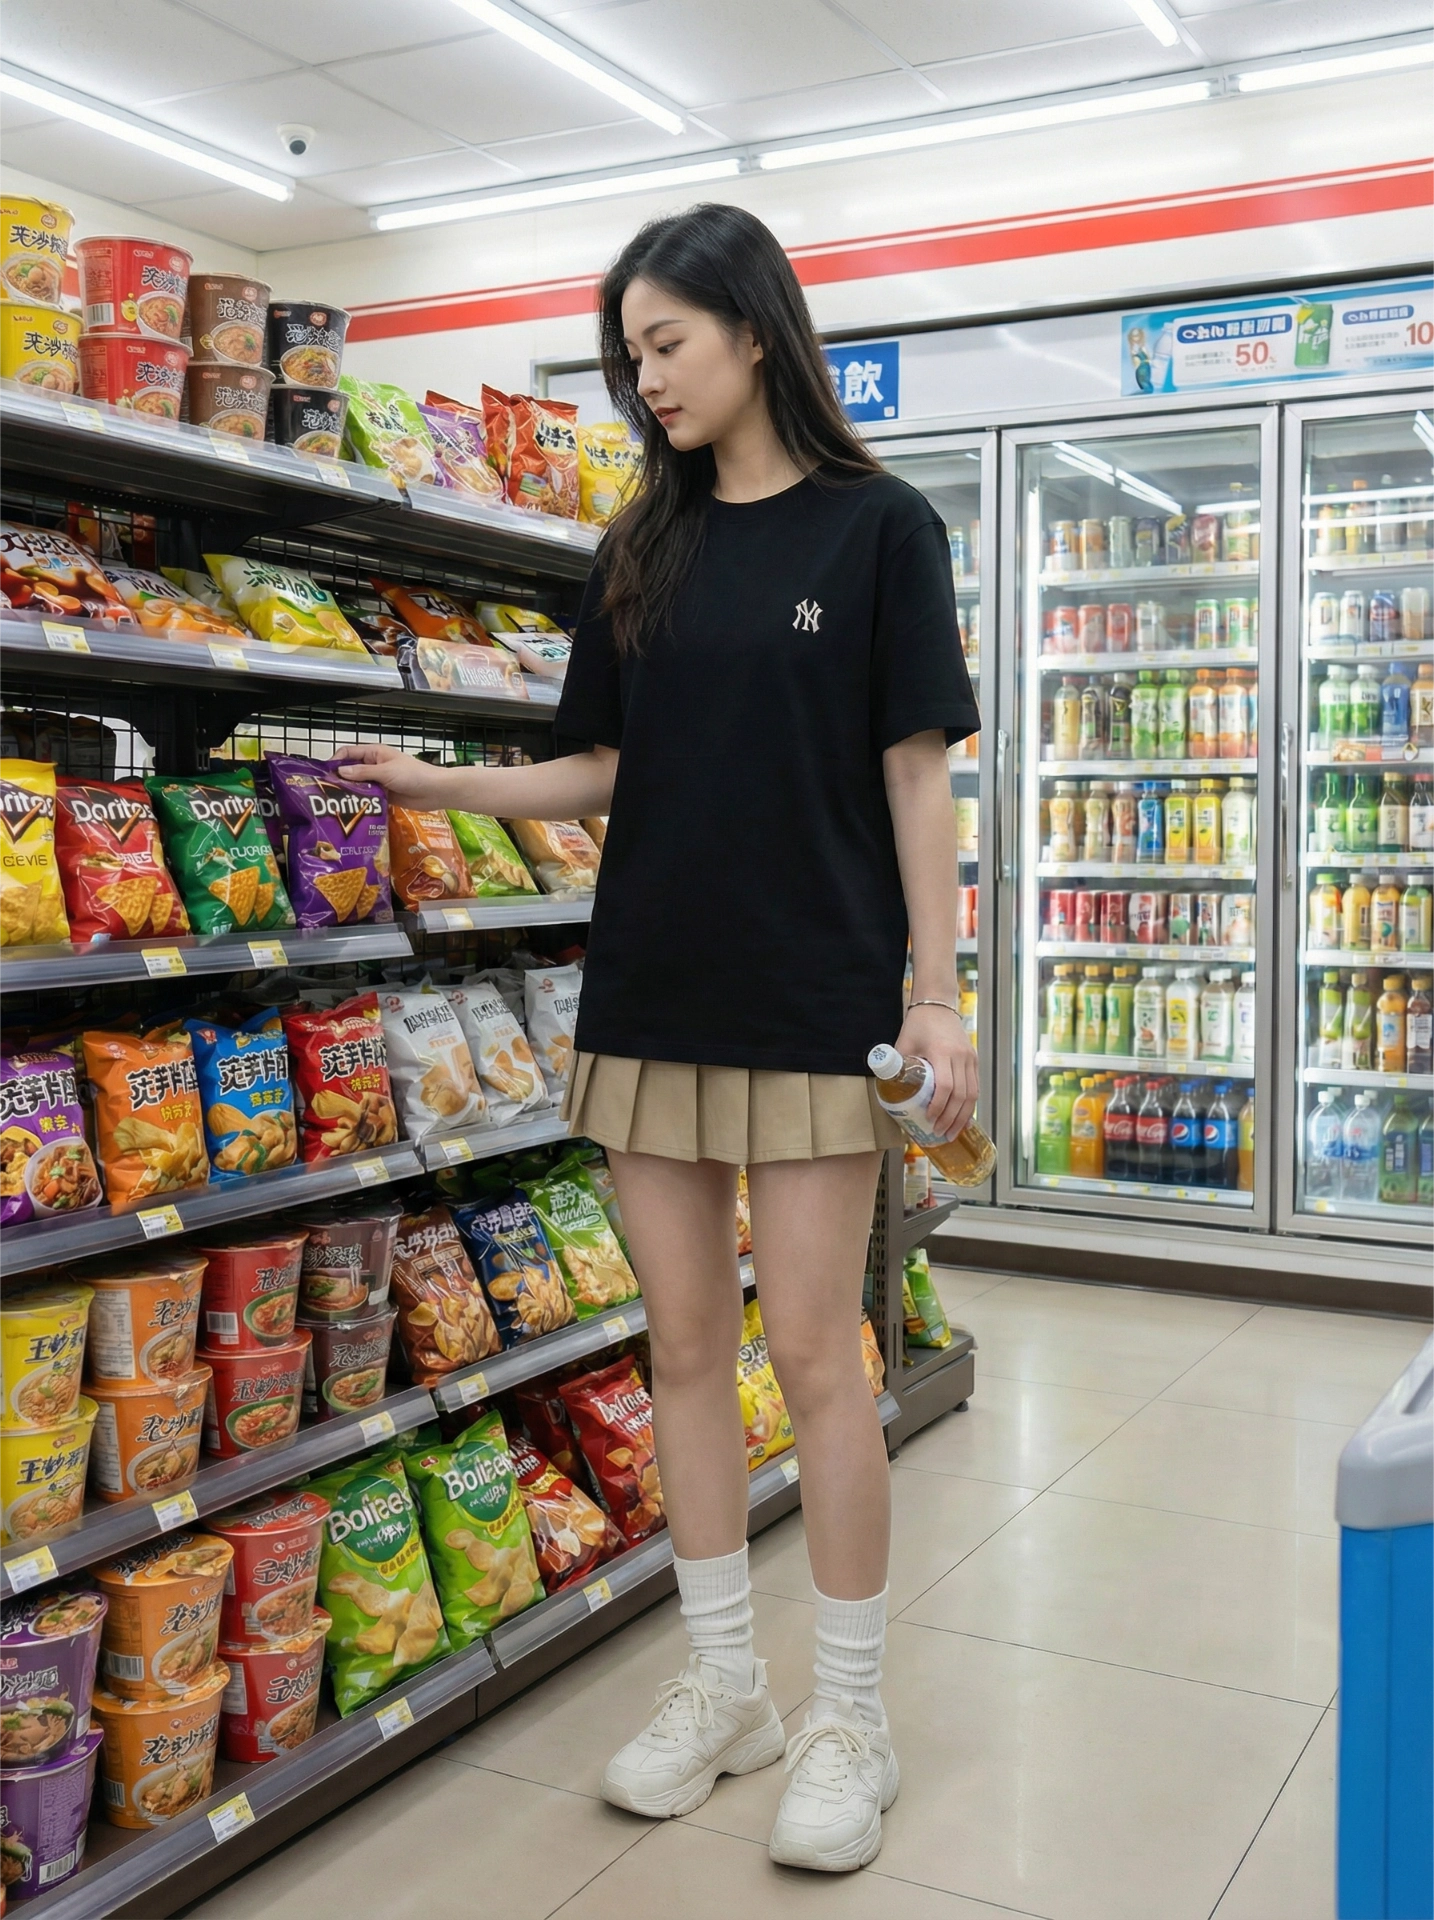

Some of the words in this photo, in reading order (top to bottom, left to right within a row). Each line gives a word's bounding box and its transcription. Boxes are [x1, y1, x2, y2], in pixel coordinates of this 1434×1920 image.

[1235, 341, 1269, 367] 50
[791, 597, 823, 633] NY
[70, 797, 156, 823] Doritos
[308, 794, 382, 816] Doritos
